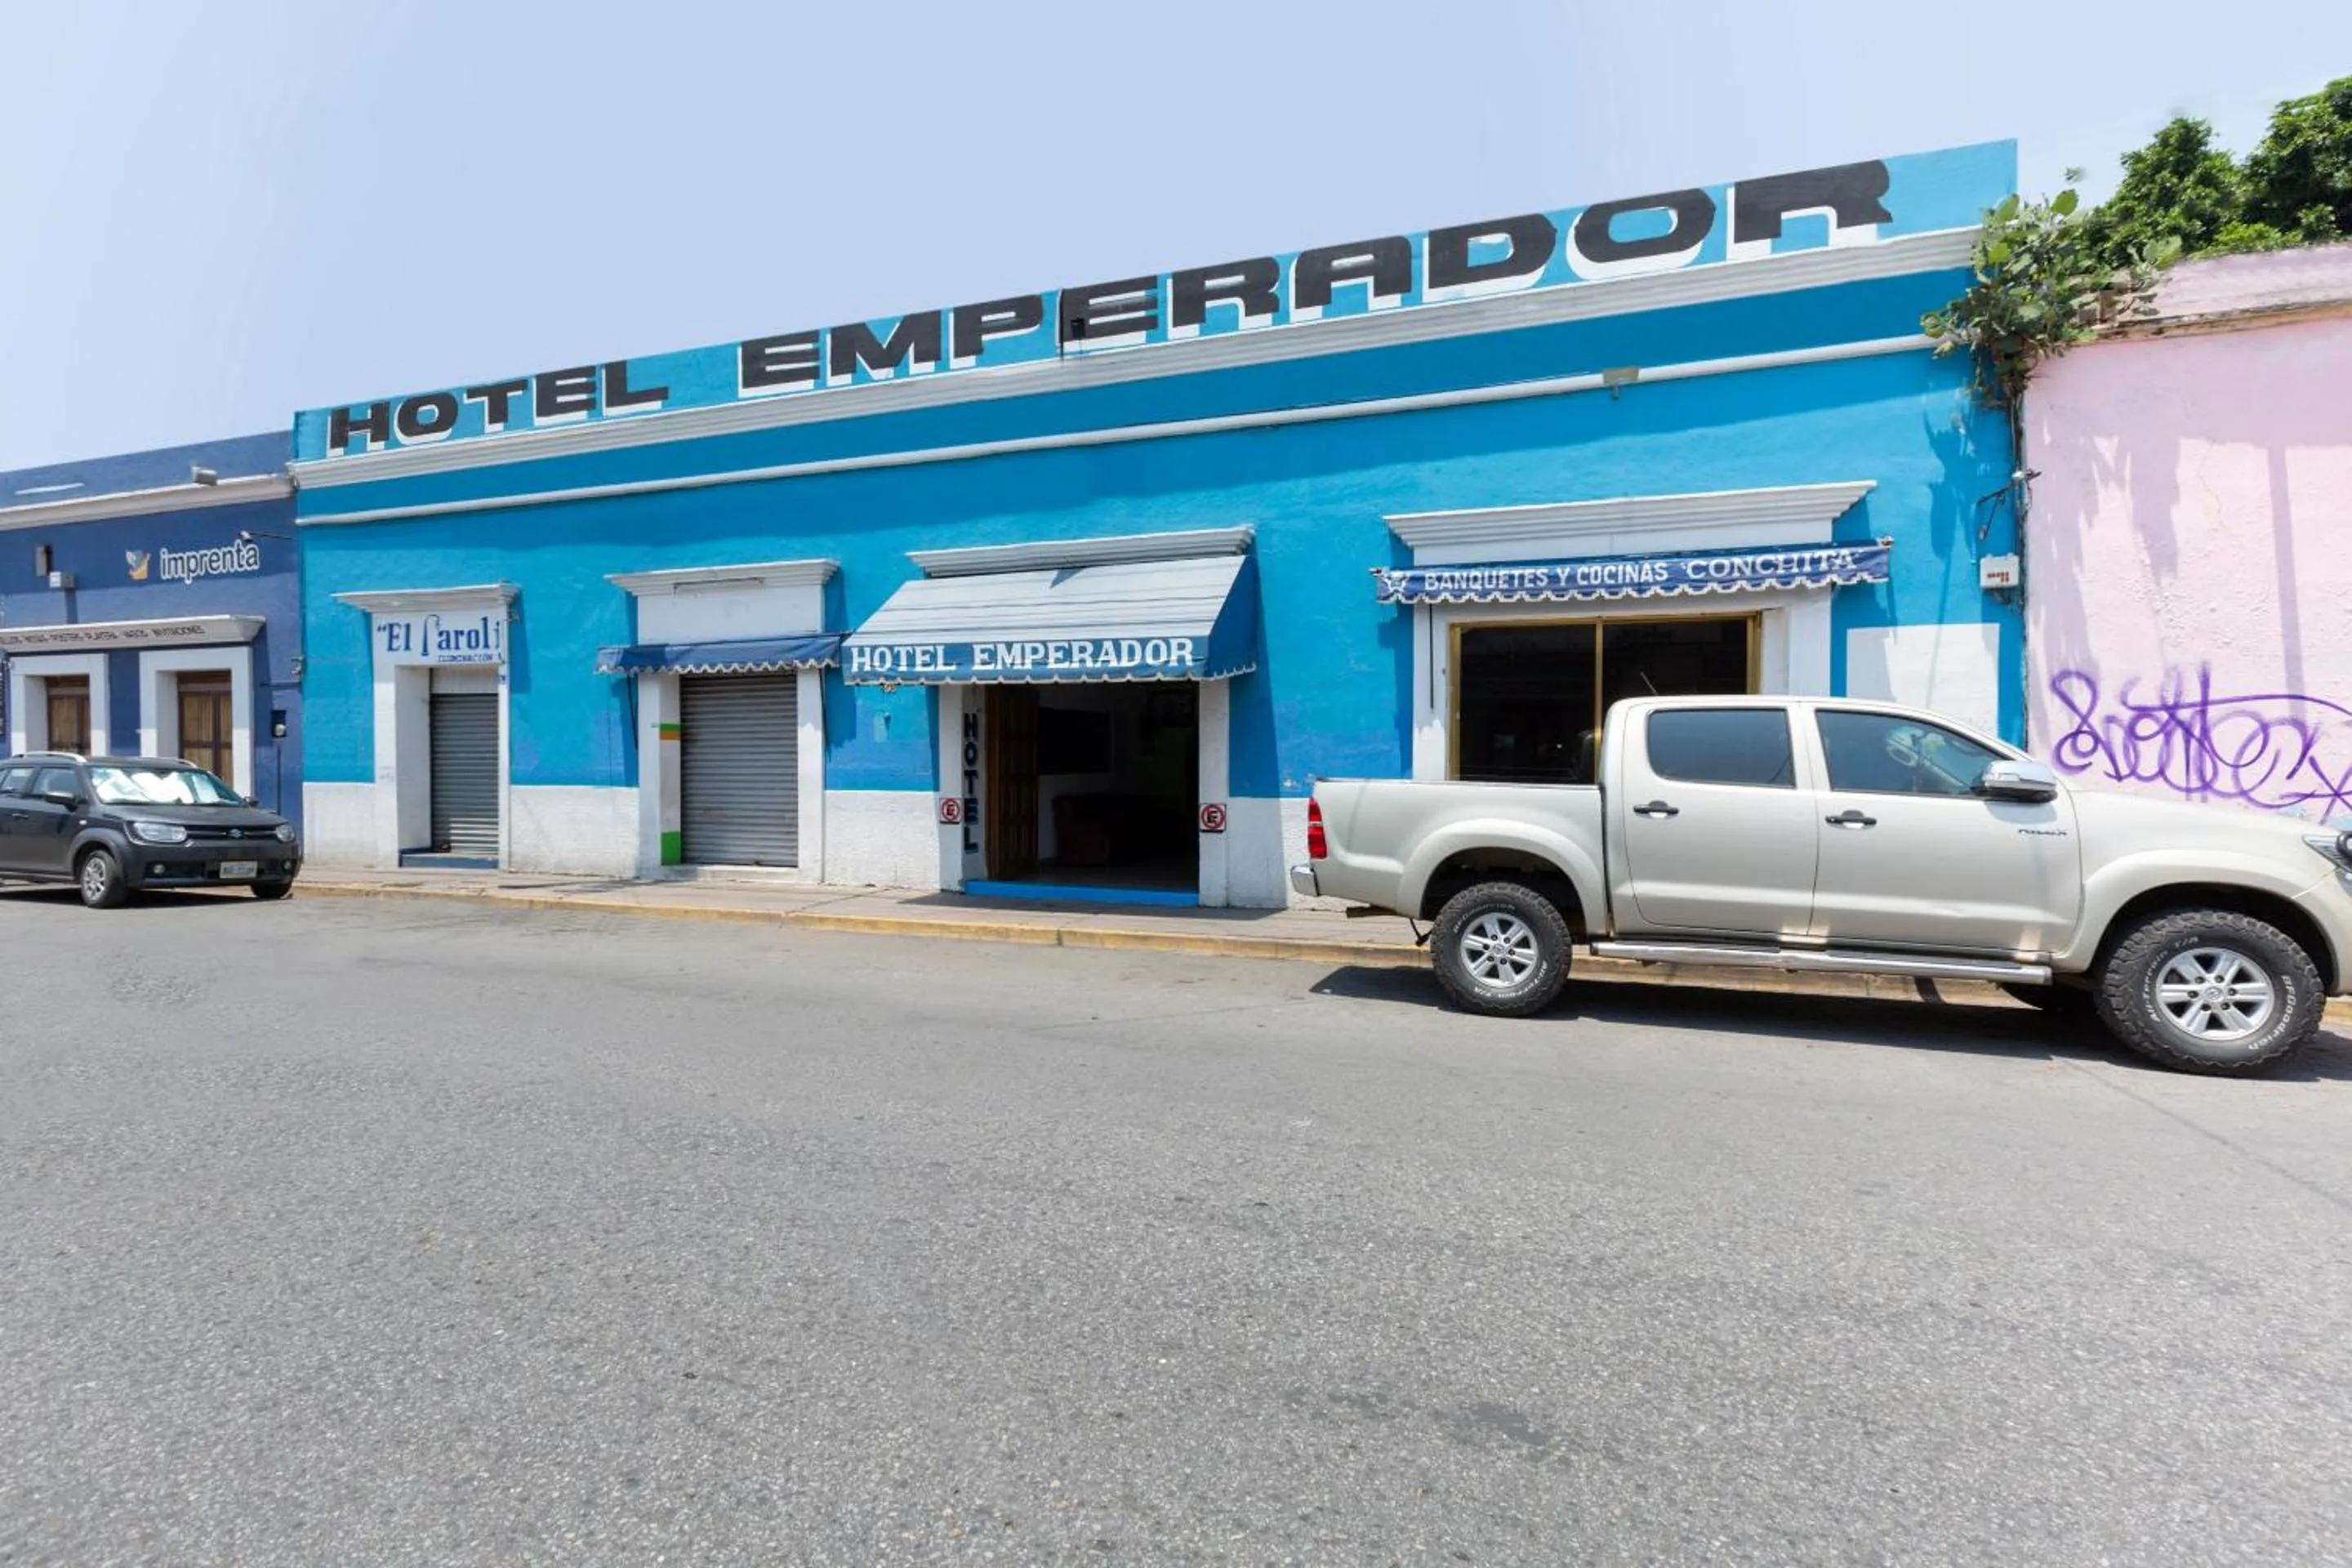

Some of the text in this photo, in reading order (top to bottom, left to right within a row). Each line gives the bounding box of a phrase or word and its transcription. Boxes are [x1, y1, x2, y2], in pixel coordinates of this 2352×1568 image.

[327, 158, 1893, 457] HOTEL EMPERADOR
[160, 539, 260, 585] imprenta
[1423, 568, 1548, 591] BANQUETES
[1557, 566, 1570, 587] Y
[1576, 562, 1668, 586] COCINAS
[851, 637, 1196, 673] HOTEL EMPERADOR
[964, 712, 979, 854] HOTEL
